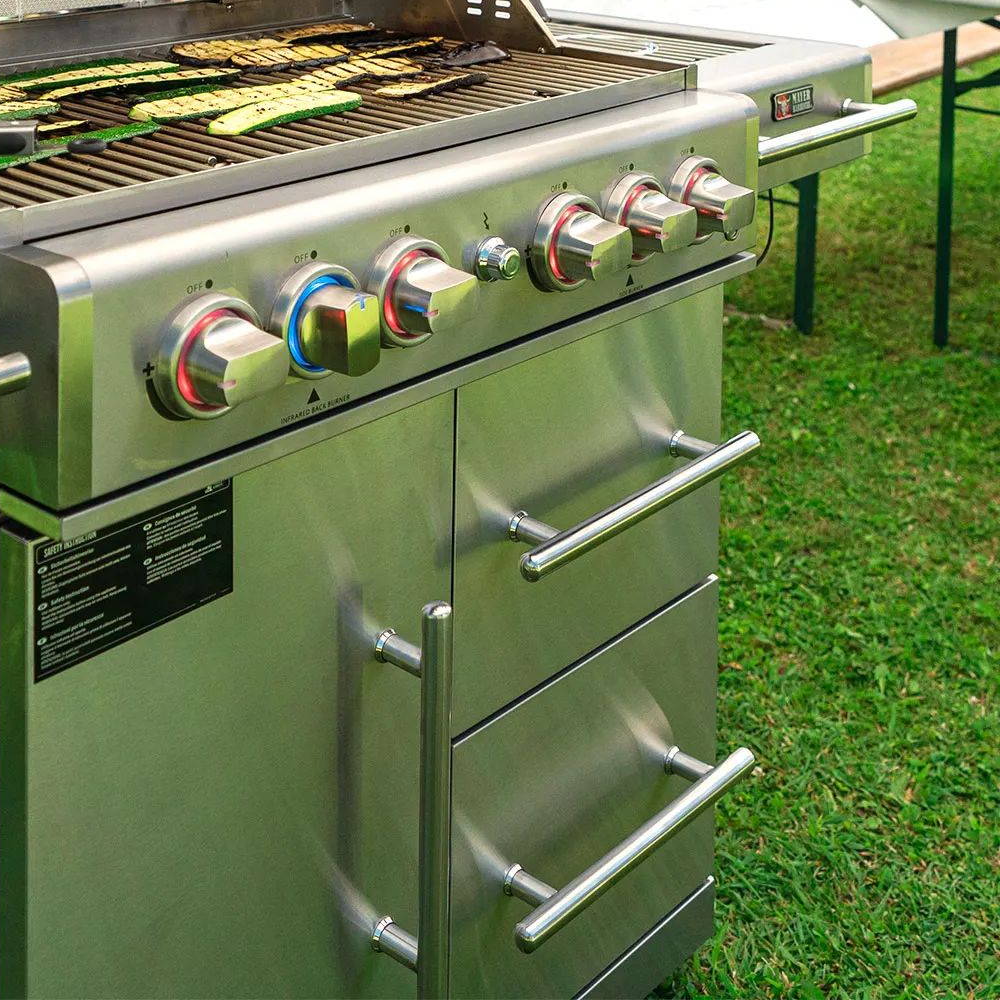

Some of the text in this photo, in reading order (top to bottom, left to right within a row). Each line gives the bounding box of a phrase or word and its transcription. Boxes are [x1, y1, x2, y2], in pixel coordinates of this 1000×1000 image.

[550, 184, 561, 193] OFF
[389, 226, 403, 238] OFF
[294, 254, 309, 264] OFF
[186, 282, 203, 295] OFF
[281, 394, 350, 424] INFRARED BACK BURNER
[43, 542, 63, 558] SAFETY
